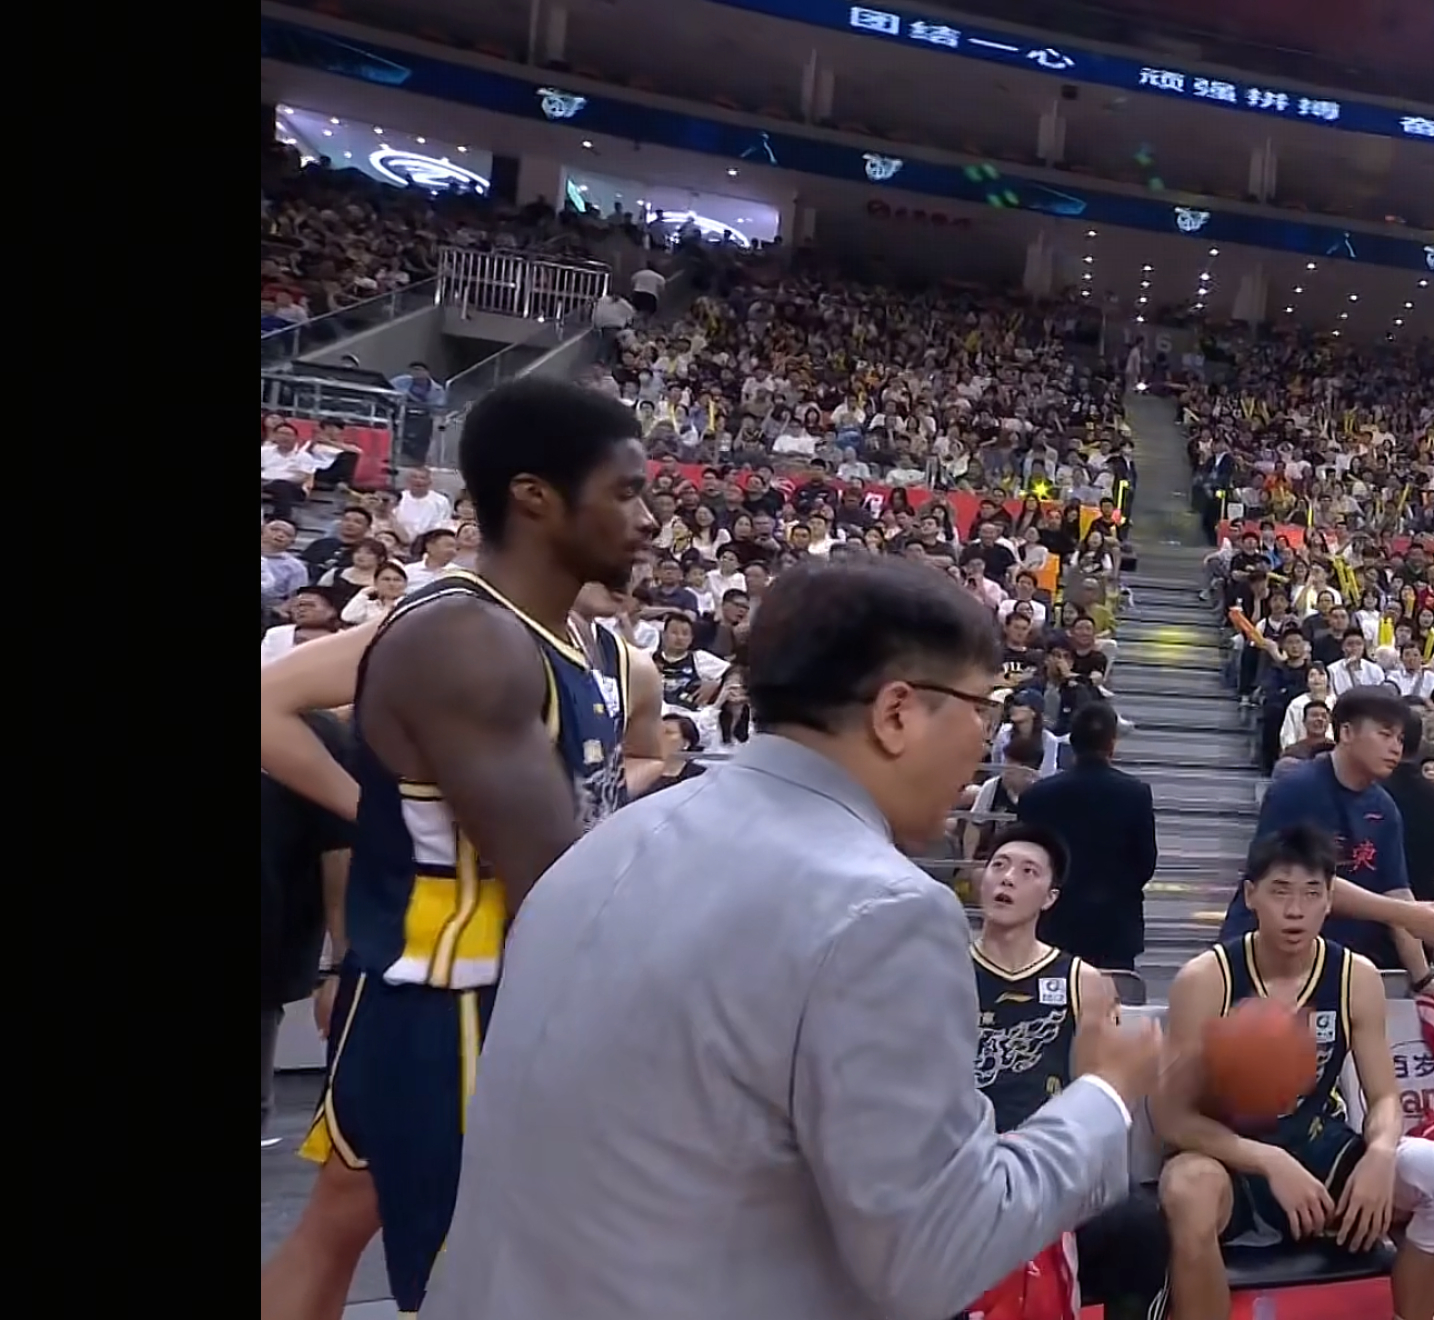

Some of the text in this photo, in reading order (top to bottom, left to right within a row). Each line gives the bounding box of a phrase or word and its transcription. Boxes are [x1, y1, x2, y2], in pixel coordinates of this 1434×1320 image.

[850, 6, 1076, 69] 团结一心
[1139, 67, 1341, 121] 顽强拼搏
